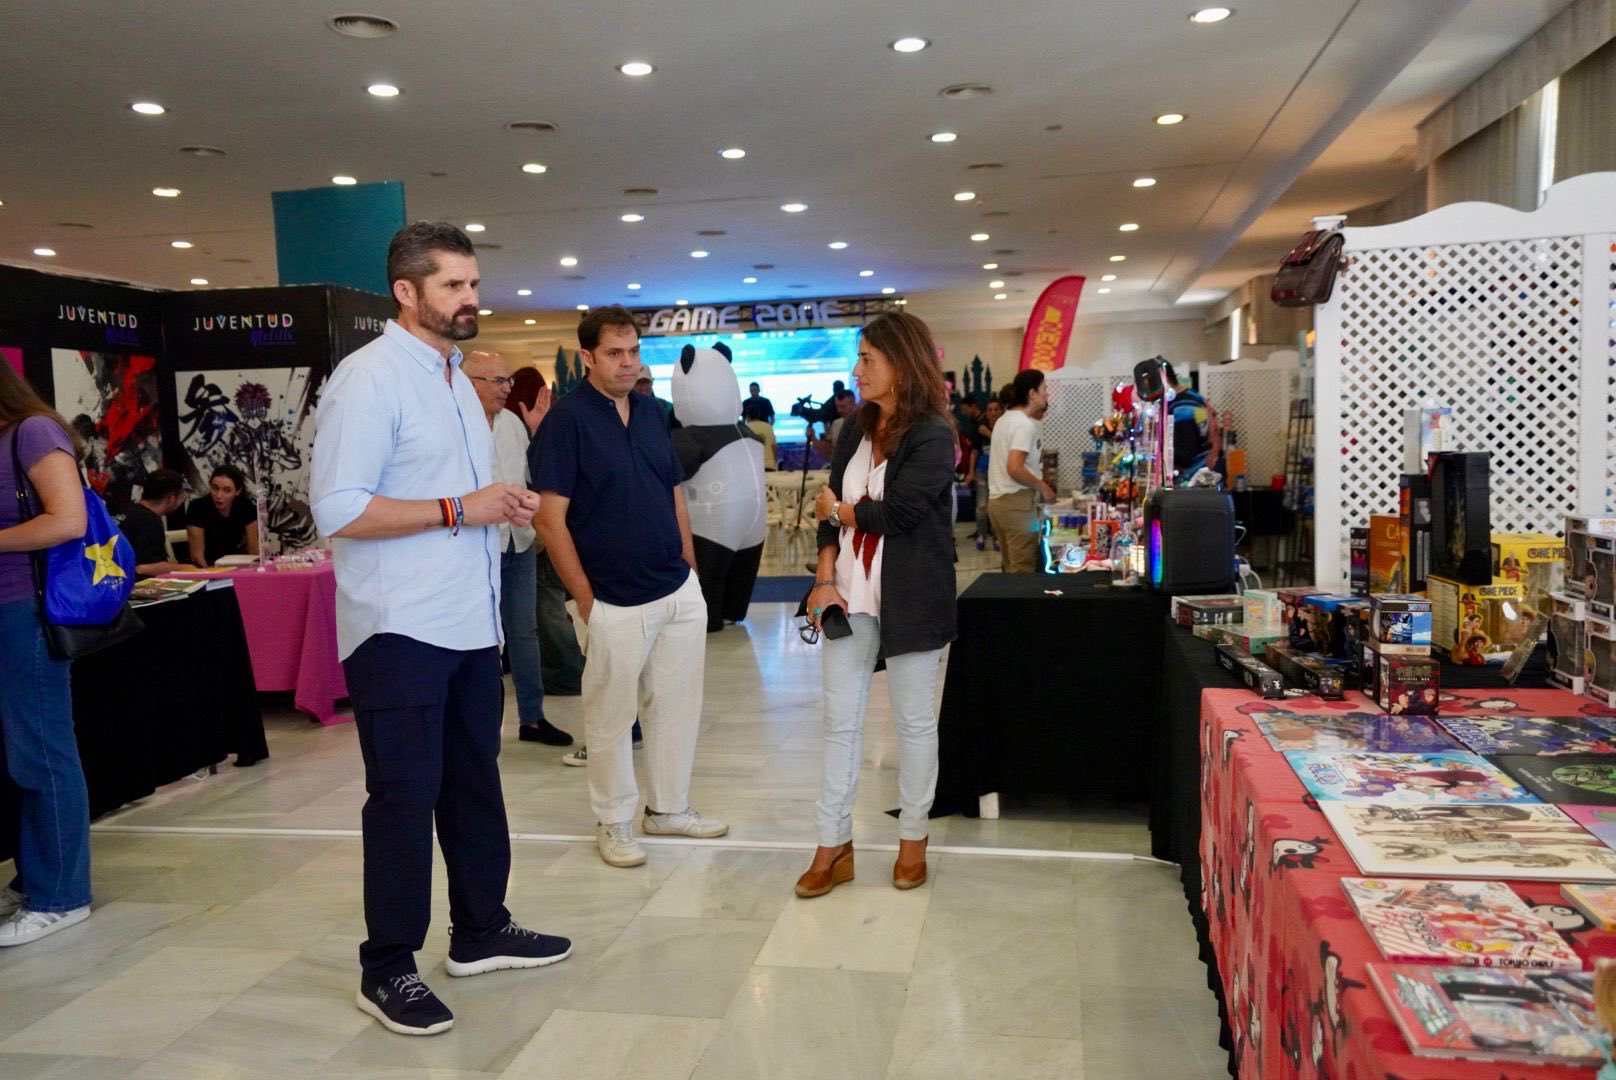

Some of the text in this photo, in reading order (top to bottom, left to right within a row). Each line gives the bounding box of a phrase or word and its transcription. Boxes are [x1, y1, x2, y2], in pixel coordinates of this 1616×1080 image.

[58, 304, 138, 329] JUVENTUD
[193, 313, 293, 331] JUVENTUD
[353, 315, 386, 332] JUVEN
[648, 300, 845, 333] GAME ZONE
